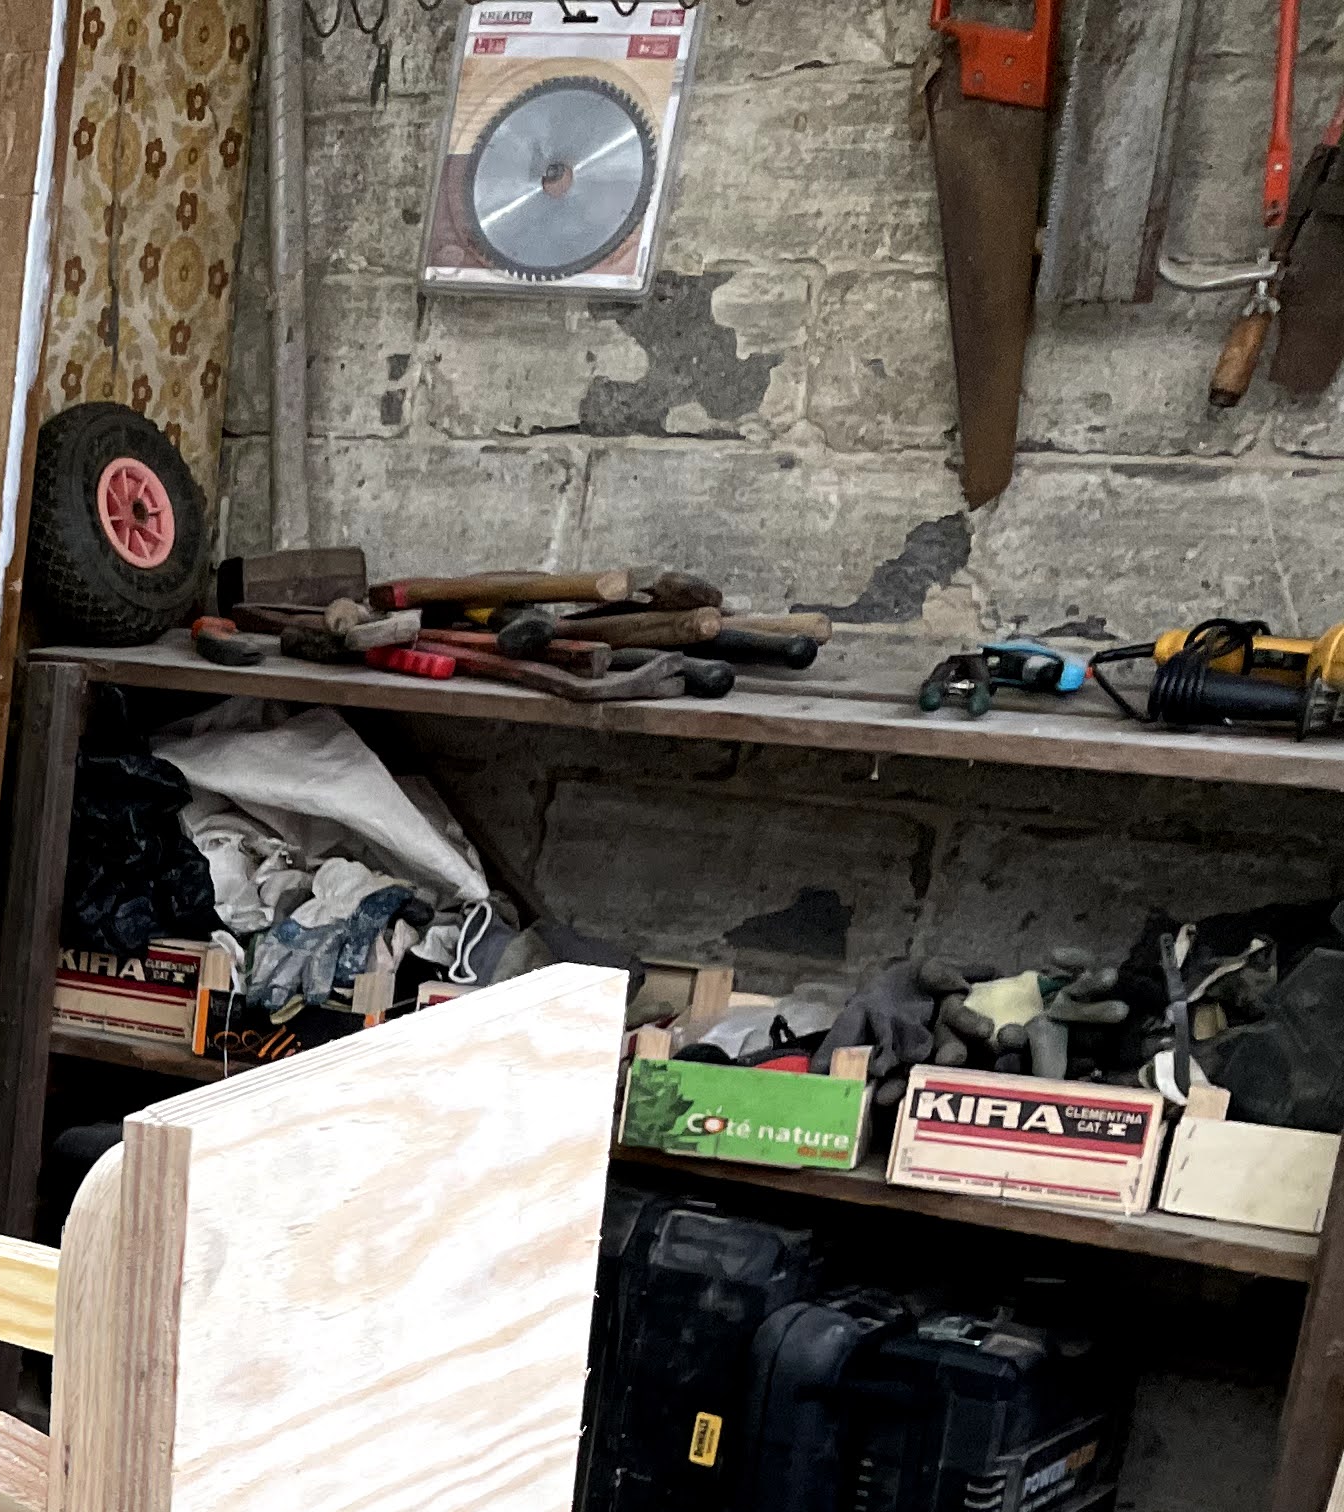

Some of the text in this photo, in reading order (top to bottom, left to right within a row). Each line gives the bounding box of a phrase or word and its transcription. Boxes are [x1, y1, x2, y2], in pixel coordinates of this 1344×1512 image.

[479, 11, 533, 21] KREATOR
[57, 949, 146, 982] KIRA
[916, 1091, 1064, 1135] KIRA
[1065, 1105, 1142, 1125] CLEMENTINA
[758, 1124, 849, 1149] nature
